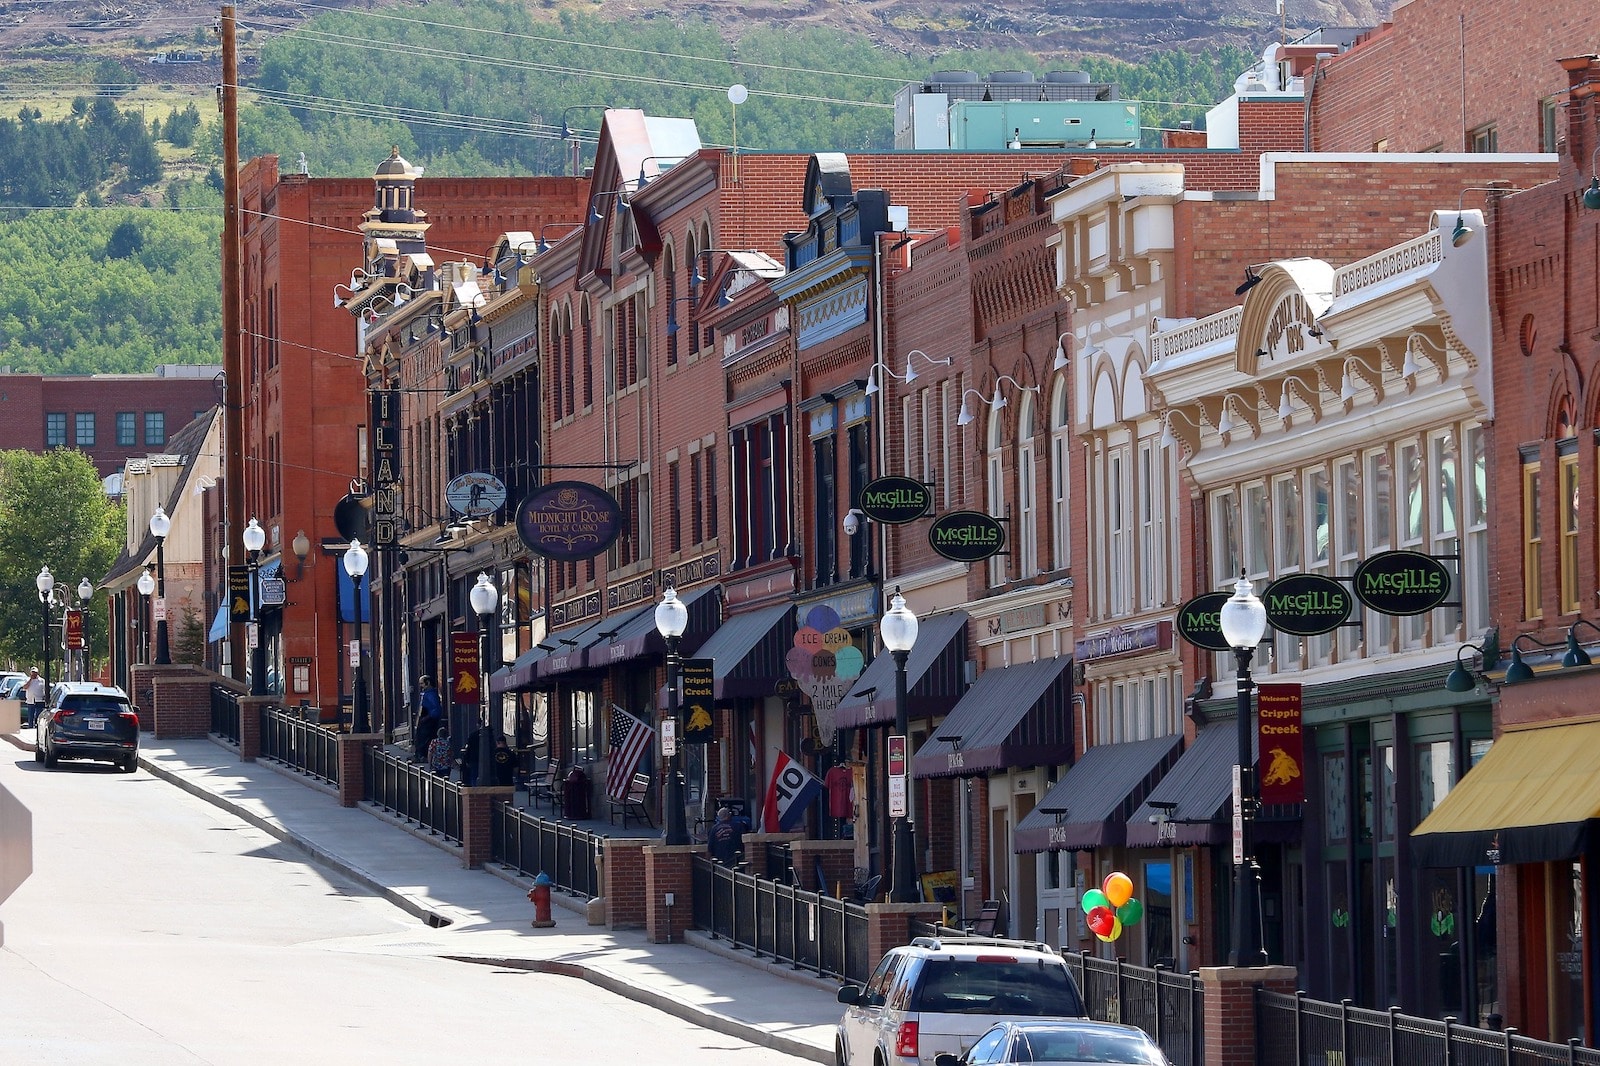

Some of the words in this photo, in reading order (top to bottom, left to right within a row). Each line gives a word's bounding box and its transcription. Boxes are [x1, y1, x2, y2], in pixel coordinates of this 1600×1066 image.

[1286, 323, 1304, 354] 1896
[866, 488, 924, 508] McGills
[528, 511, 577, 524] MIDNIGHT
[581, 510, 610, 523] ROSE
[540, 524, 560, 533] HOTEL
[571, 523, 598, 532] CASINO
[936, 525, 997, 546] McGills
[1364, 569, 1441, 595] McGills
[1270, 590, 1344, 616] McGills
[802, 633, 818, 644] ICE
[824, 633, 848, 644] CREAM
[813, 655, 836, 667] CONES
[684, 677, 712, 685] Cripple
[684, 687, 712, 696] Creek
[812, 684, 818, 698] 2
[822, 684, 843, 698] MILE
[816, 699, 837, 711] HIGH
[1260, 709, 1299, 719] Cripple
[1260, 724, 1300, 735] Creek
